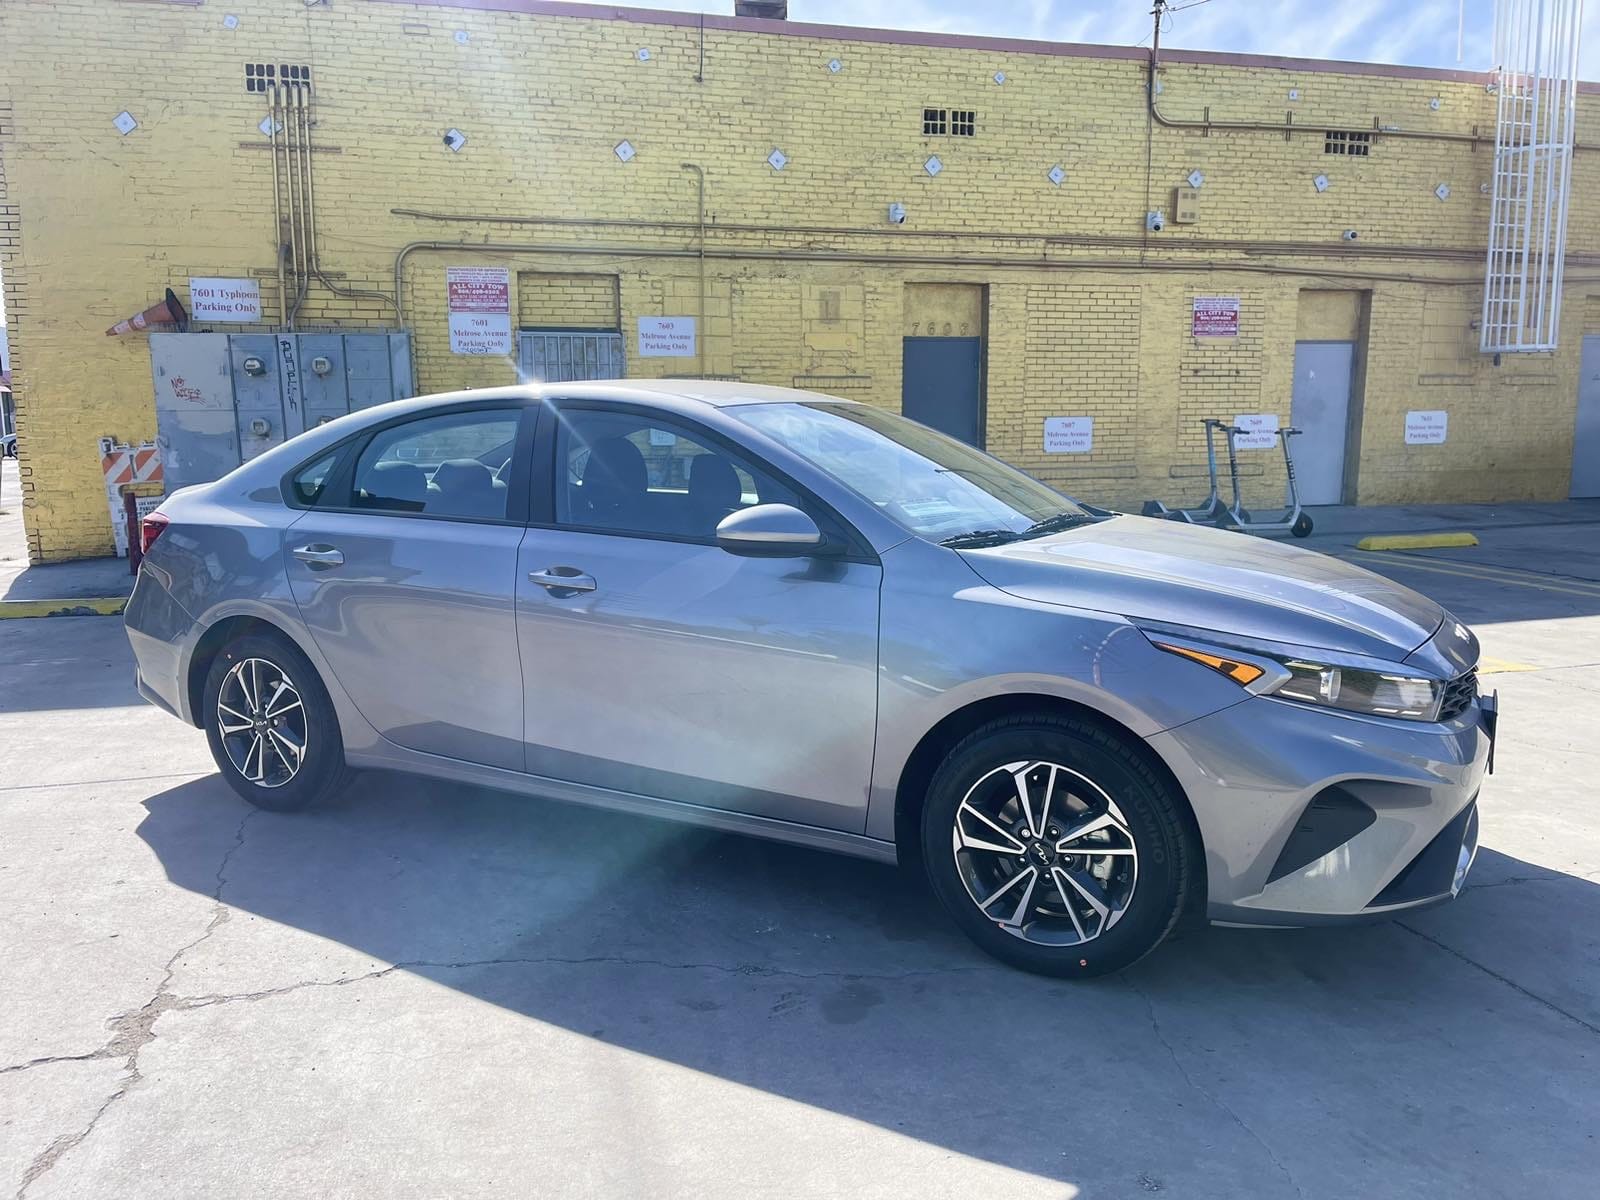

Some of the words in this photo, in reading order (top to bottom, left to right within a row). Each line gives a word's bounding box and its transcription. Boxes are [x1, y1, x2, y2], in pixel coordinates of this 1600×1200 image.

[192, 288, 215, 297] 7601
[218, 288, 258, 300] Typhoon
[195, 301, 232, 313] Parking
[235, 303, 257, 314] Only
[471, 319, 488, 327] 7601
[453, 329, 481, 337] Melrose
[482, 329, 508, 337] Avenue
[458, 339, 486, 348] Parking
[487, 340, 504, 348] Only
